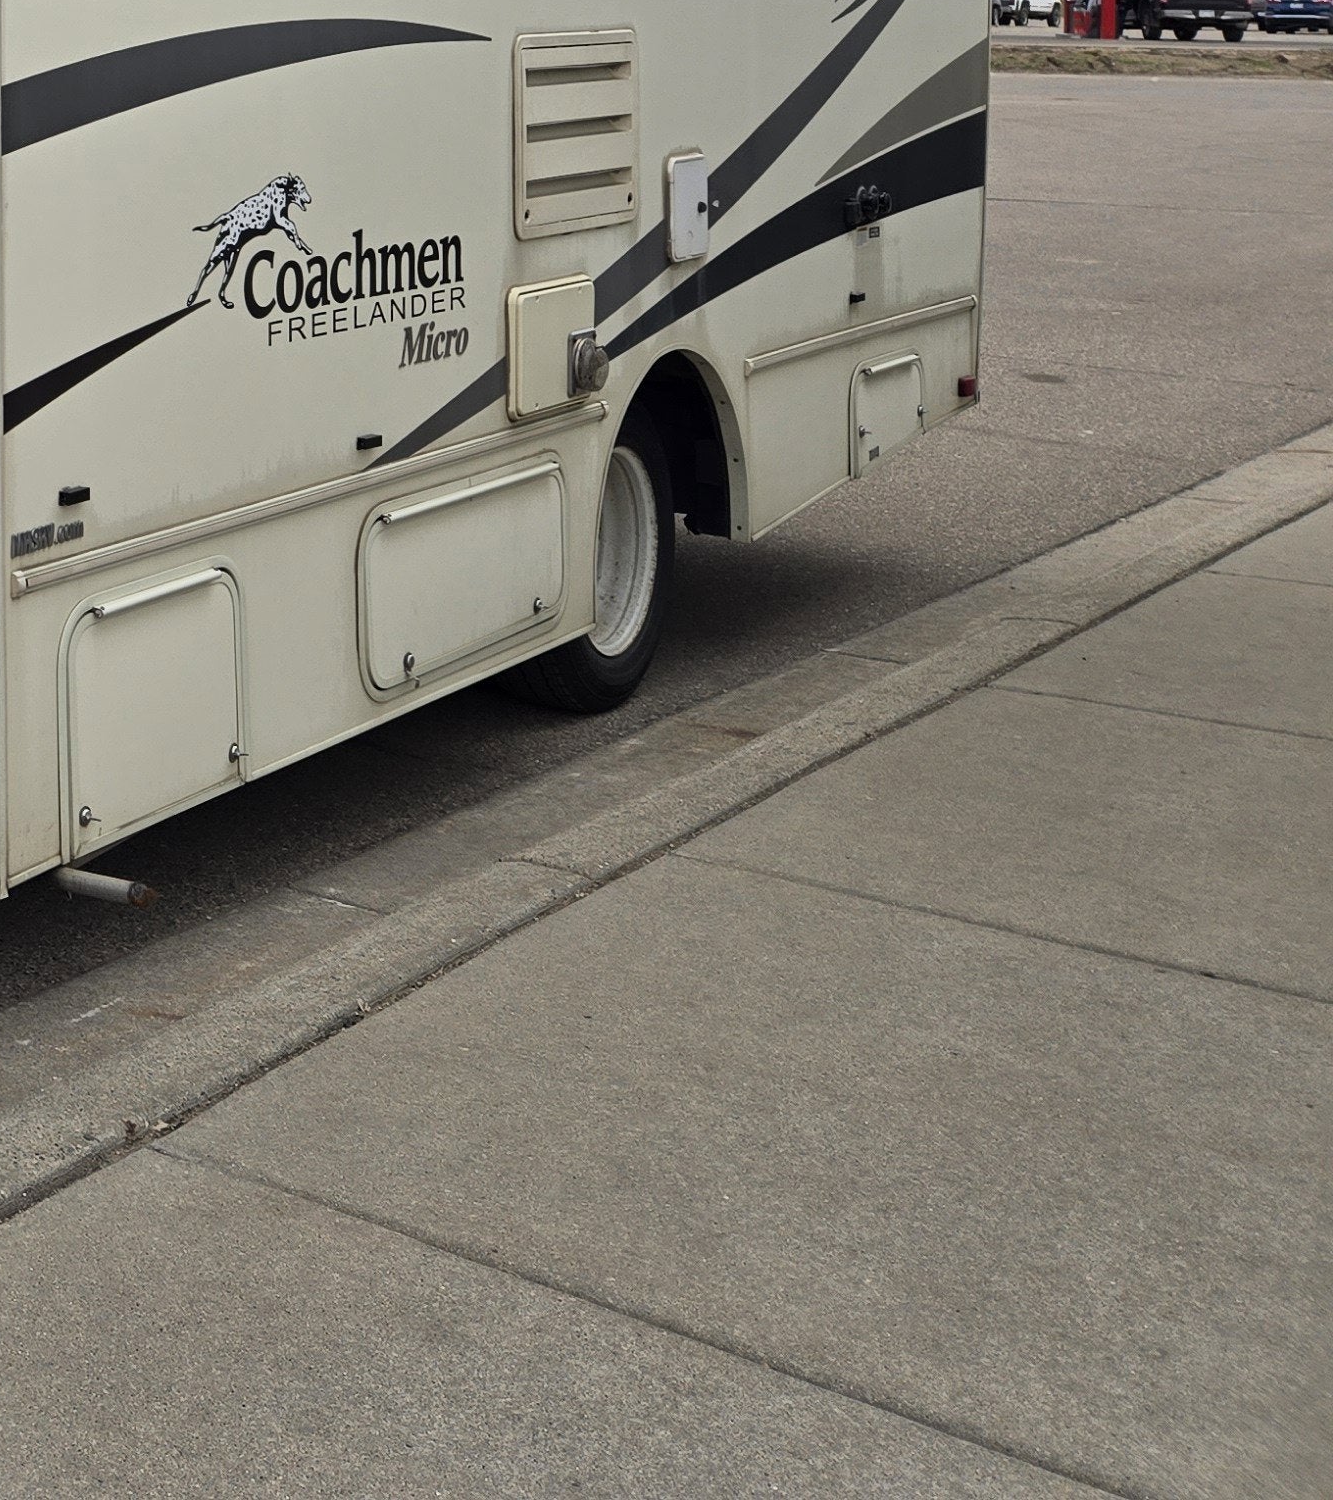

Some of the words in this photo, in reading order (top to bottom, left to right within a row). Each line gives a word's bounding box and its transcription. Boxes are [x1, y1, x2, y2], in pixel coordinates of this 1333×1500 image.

[243, 228, 464, 319] Coachmen
[268, 287, 466, 346] FREELANDER
[398, 321, 469, 369] Micro
